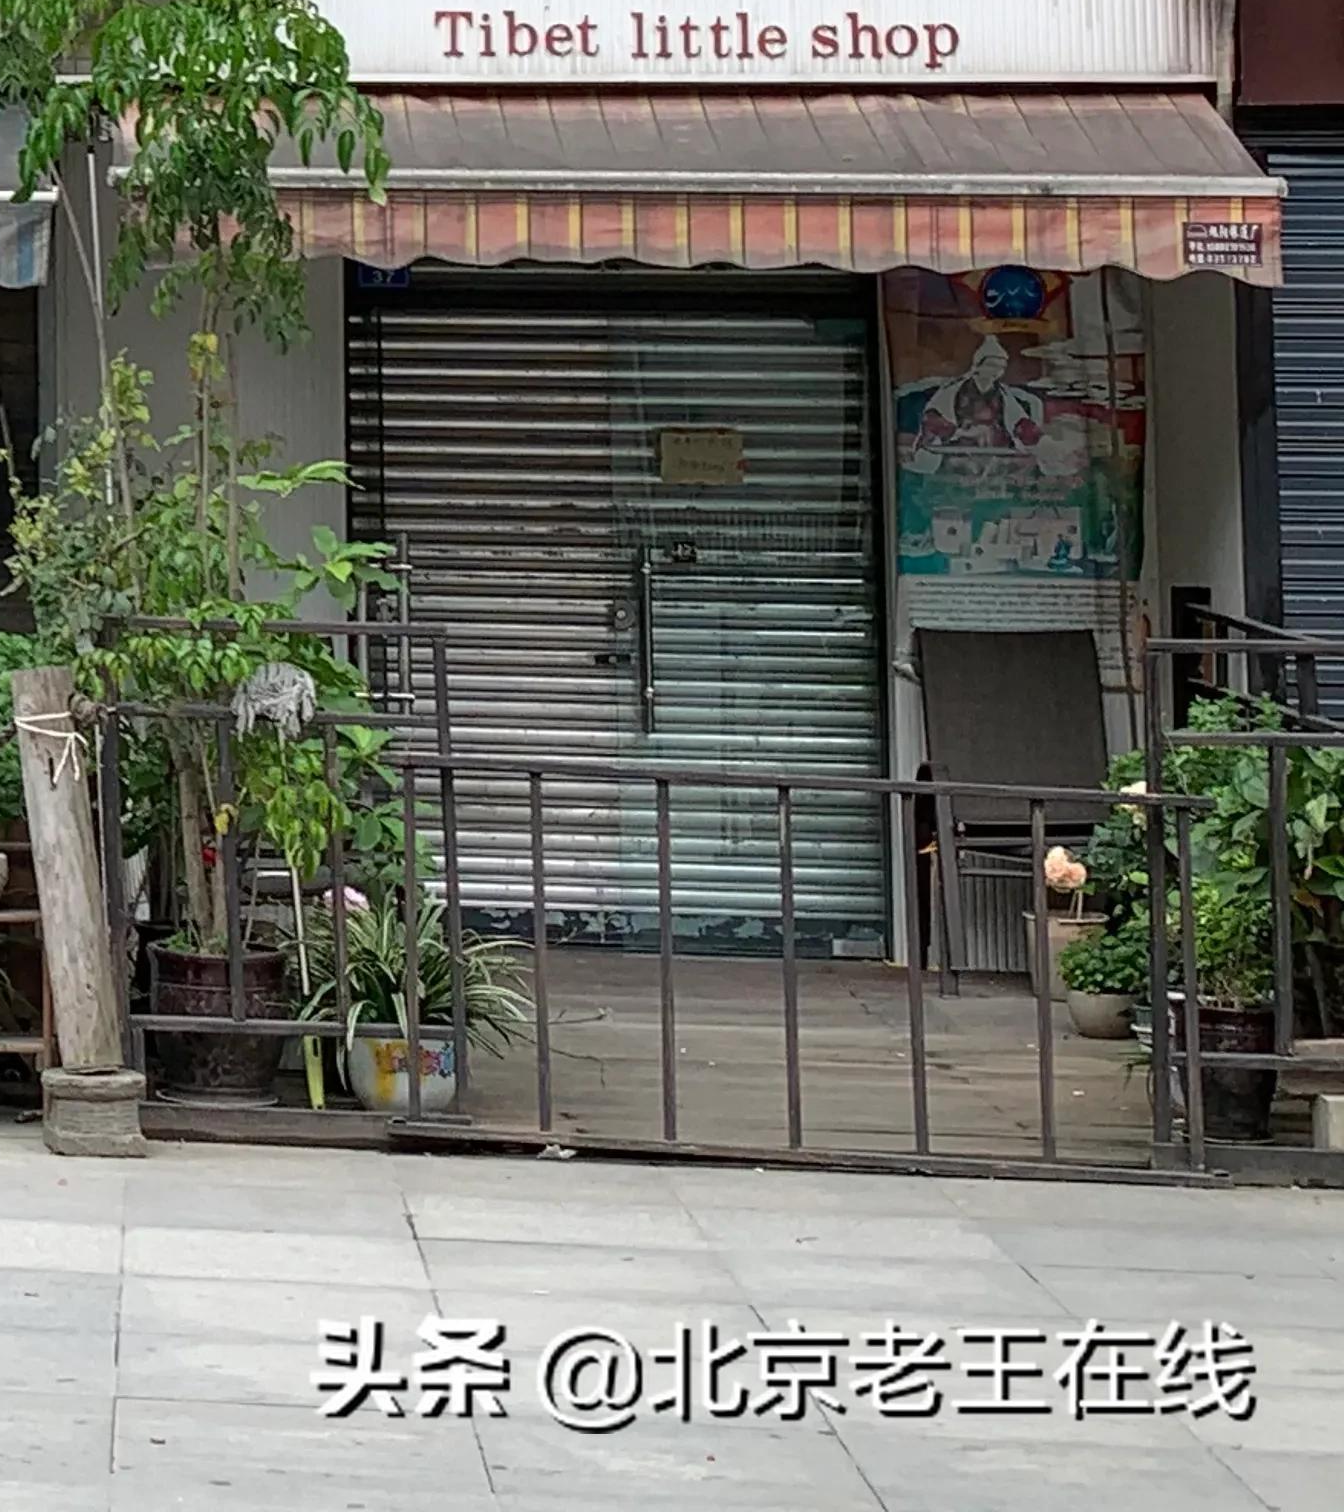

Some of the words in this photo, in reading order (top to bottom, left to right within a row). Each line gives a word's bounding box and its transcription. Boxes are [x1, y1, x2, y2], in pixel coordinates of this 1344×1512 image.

[433, 10, 600, 60] Tibet
[631, 10, 787, 60] little
[810, 10, 960, 71] shop
